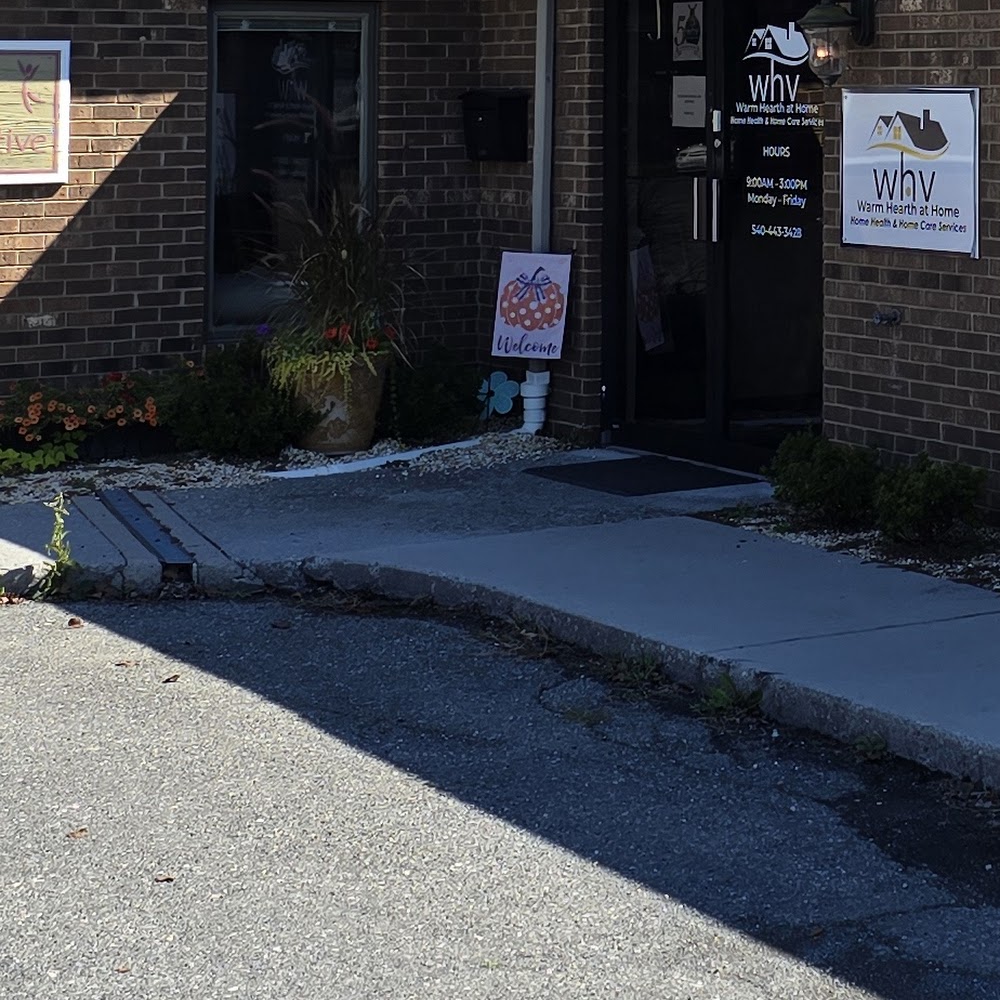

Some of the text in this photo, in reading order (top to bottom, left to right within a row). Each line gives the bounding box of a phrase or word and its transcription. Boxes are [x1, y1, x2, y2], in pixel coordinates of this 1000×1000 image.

[748, 59, 801, 102] whv
[735, 101, 819, 114] Warm Hearth at Home
[730, 115, 825, 127] Home Health & Home Care Services
[0, 127, 47, 154] ive
[762, 145, 791, 158] HOURS
[746, 175, 774, 189] 9:00AM
[779, 177, 808, 191] 3:00PM
[872, 150, 936, 202] whv
[747, 192, 777, 208] Monday
[782, 193, 807, 209] Friday
[857, 200, 960, 218] Warm Hearth at Home
[850, 216, 967, 233] Home Health & Home Care Services
[497, 333, 559, 356] Welcome
